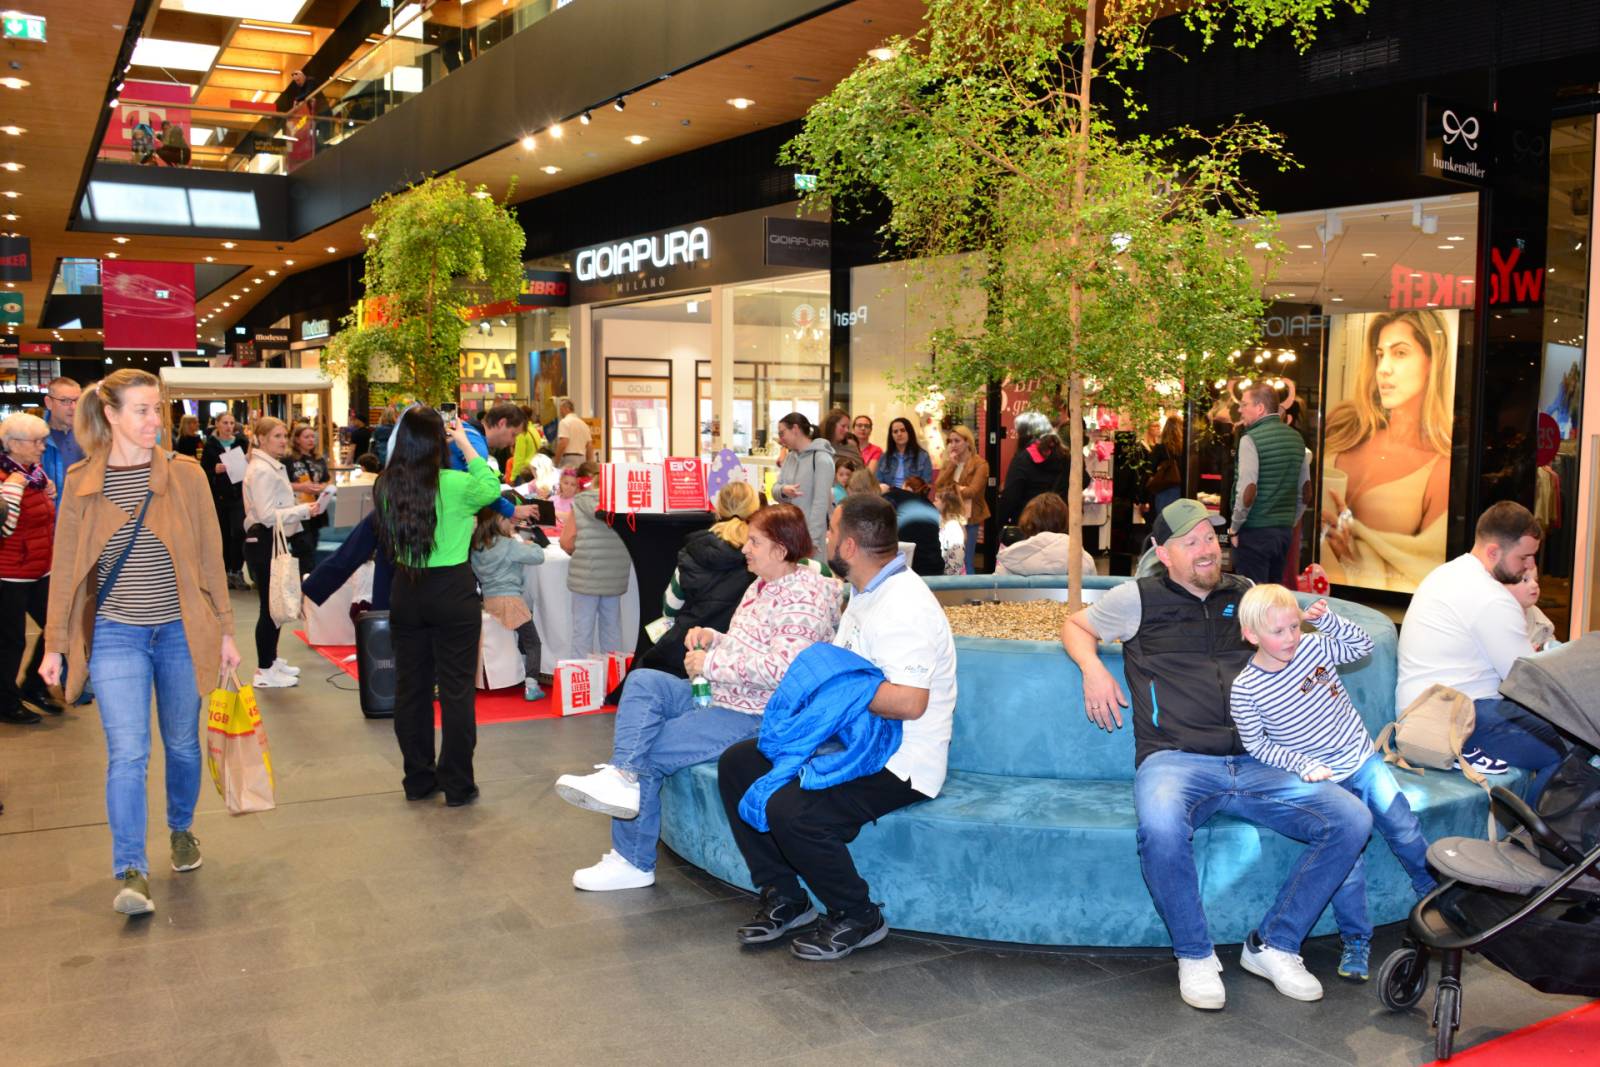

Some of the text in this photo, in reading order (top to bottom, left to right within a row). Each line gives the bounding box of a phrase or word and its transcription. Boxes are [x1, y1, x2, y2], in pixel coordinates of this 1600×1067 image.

[1433, 152, 1486, 178] hunkemöller
[769, 234, 829, 247] GIOIAPURA
[576, 226, 710, 281] GIOIAPURA
[616, 276, 665, 292] MILANO
[628, 385, 652, 393] GOLD
[628, 470, 651, 482] ALLE
[571, 671, 589, 683] ALLE
